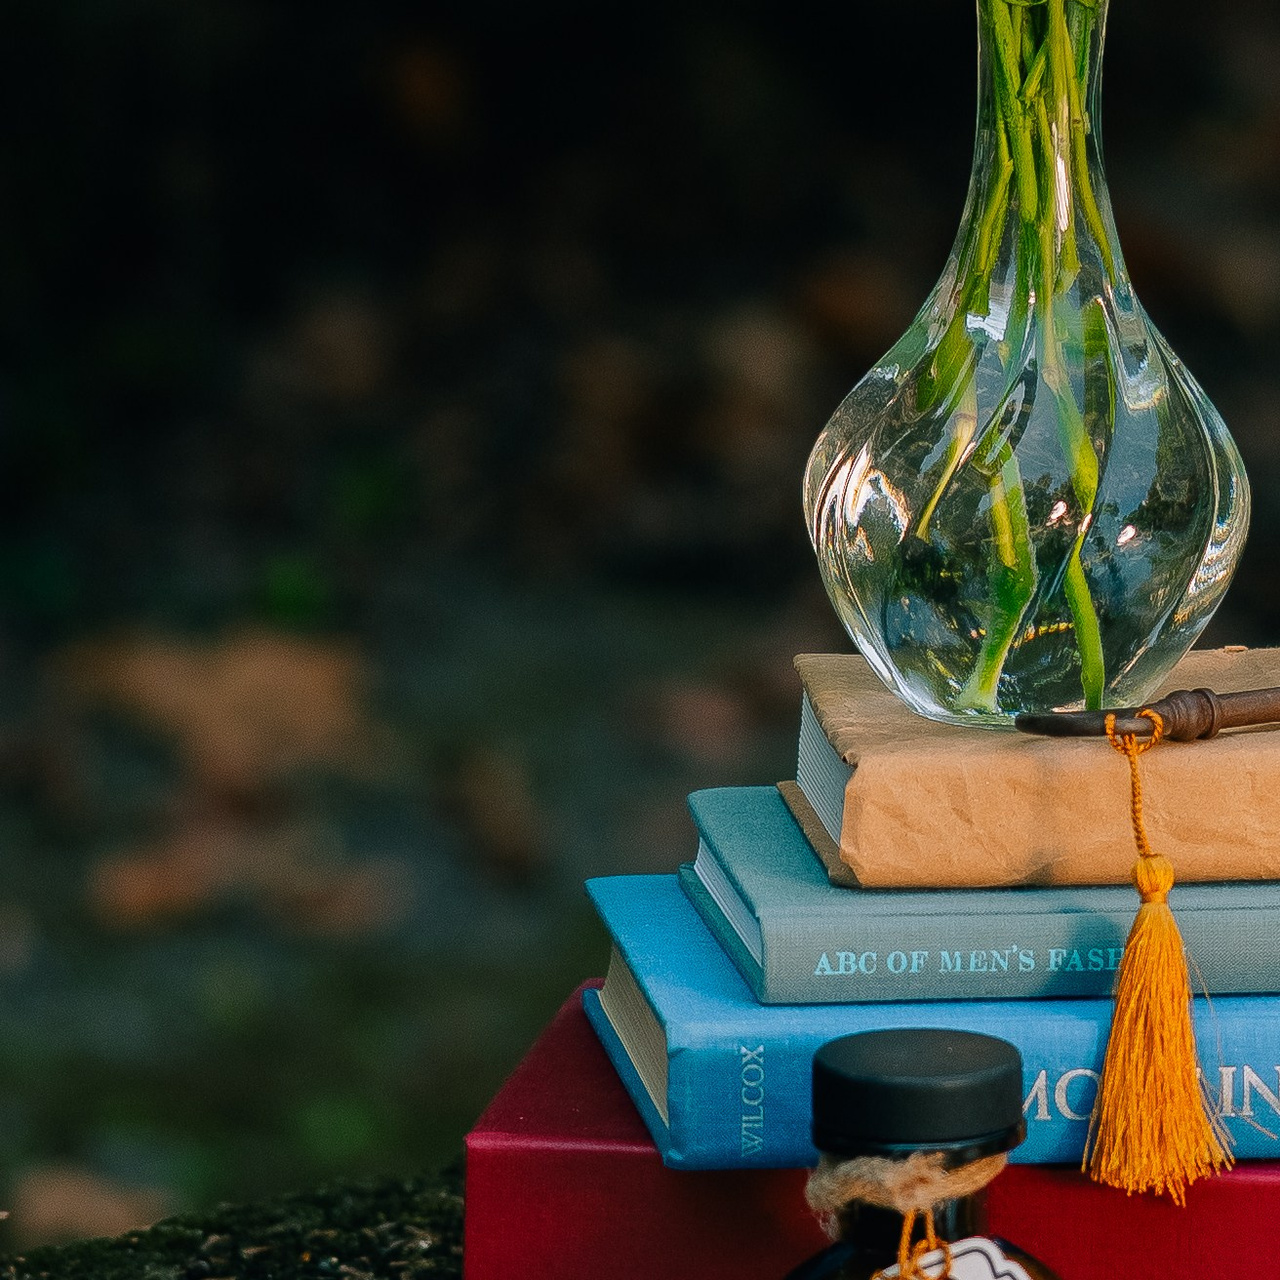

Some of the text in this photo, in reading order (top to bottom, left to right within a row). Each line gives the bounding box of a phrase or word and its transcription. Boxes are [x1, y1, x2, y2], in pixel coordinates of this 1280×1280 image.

[814, 945, 1125, 976] ABC OF MEN'S FASH
[741, 1043, 766, 1158] WILCOX
